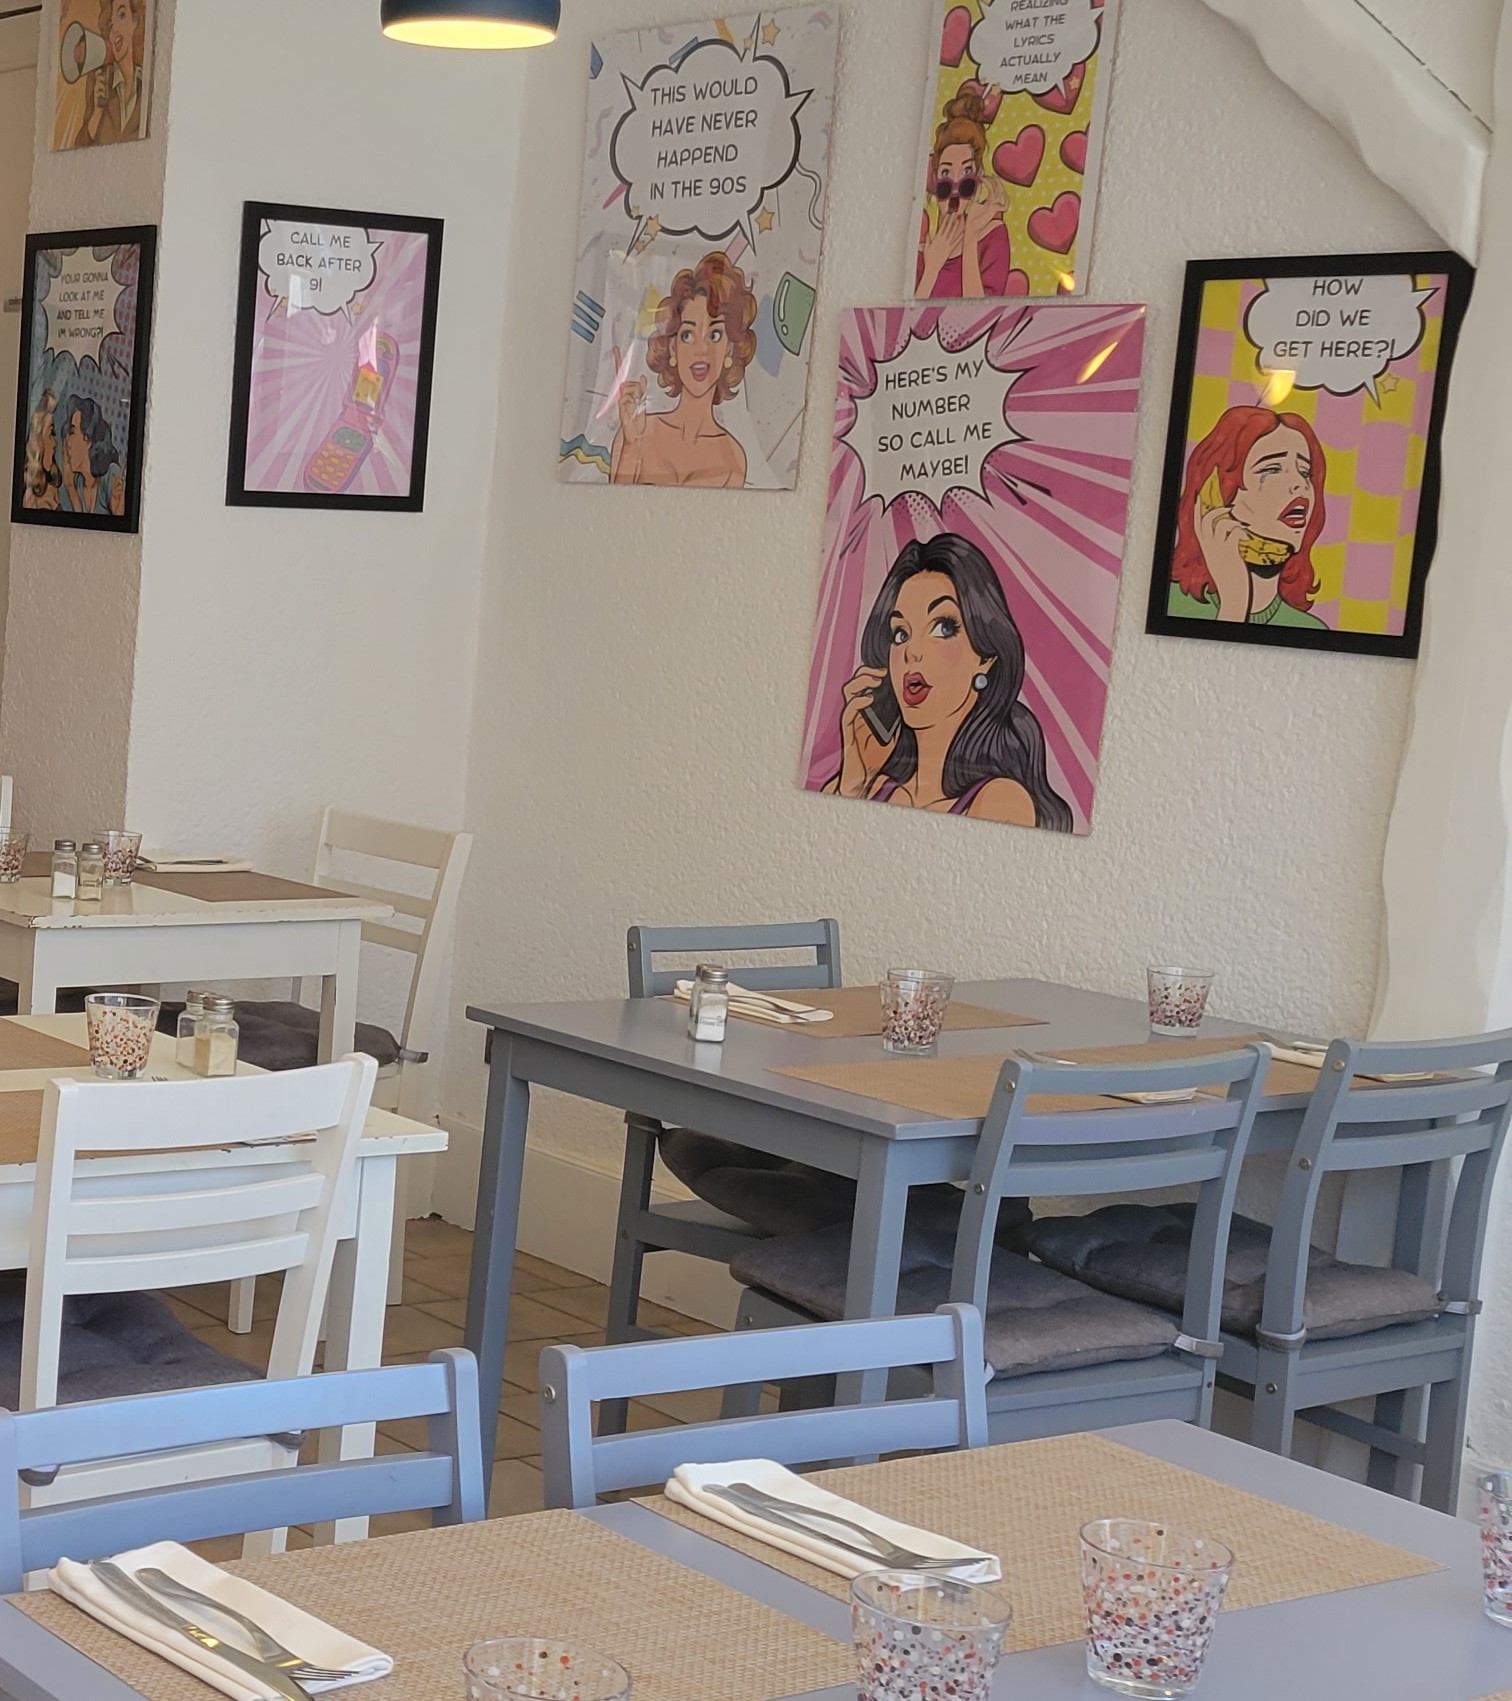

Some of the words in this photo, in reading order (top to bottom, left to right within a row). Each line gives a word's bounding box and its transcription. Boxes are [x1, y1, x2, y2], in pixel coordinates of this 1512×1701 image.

[1005, 17, 1040, 30] WHAT
[1043, 14, 1066, 27] THE
[1014, 34, 1055, 48] LYRICS
[1000, 51, 1062, 68] ACTUALLY
[1013, 72, 1048, 85] MEAN
[651, 85, 687, 106] THIS
[693, 76, 758, 101] WOULD
[651, 116, 696, 138] HAVE
[701, 109, 758, 132] NEVER
[657, 144, 738, 168] HAPPEND
[650, 182, 665, 200] IN
[671, 179, 703, 199] THE
[709, 176, 747, 195] 90S
[290, 231, 325, 246] CALL
[330, 234, 351, 248] ME
[276, 253, 313, 268] BACK
[318, 257, 362, 272] AFTER
[82, 272, 108, 283] GONNA
[59, 291, 78, 302] LOOK
[80, 291, 90, 301] AT
[92, 290, 105, 301] ME
[1312, 278, 1364, 296] HOW
[57, 310, 72, 320] AND
[74, 309, 90, 320] TELL
[93, 309, 105, 319] ME
[1296, 310, 1331, 327] DID
[1339, 309, 1372, 327] WE
[1273, 341, 1314, 358] GET
[1320, 338, 1396, 359] HERE?!
[885, 365, 948, 391] HERE'S
[955, 359, 984, 381] MY
[892, 394, 971, 421] NUMBER
[878, 434, 904, 452] SO
[910, 427, 956, 448] CALL
[963, 422, 992, 442] ME
[900, 454, 969, 481] MAYBE!
